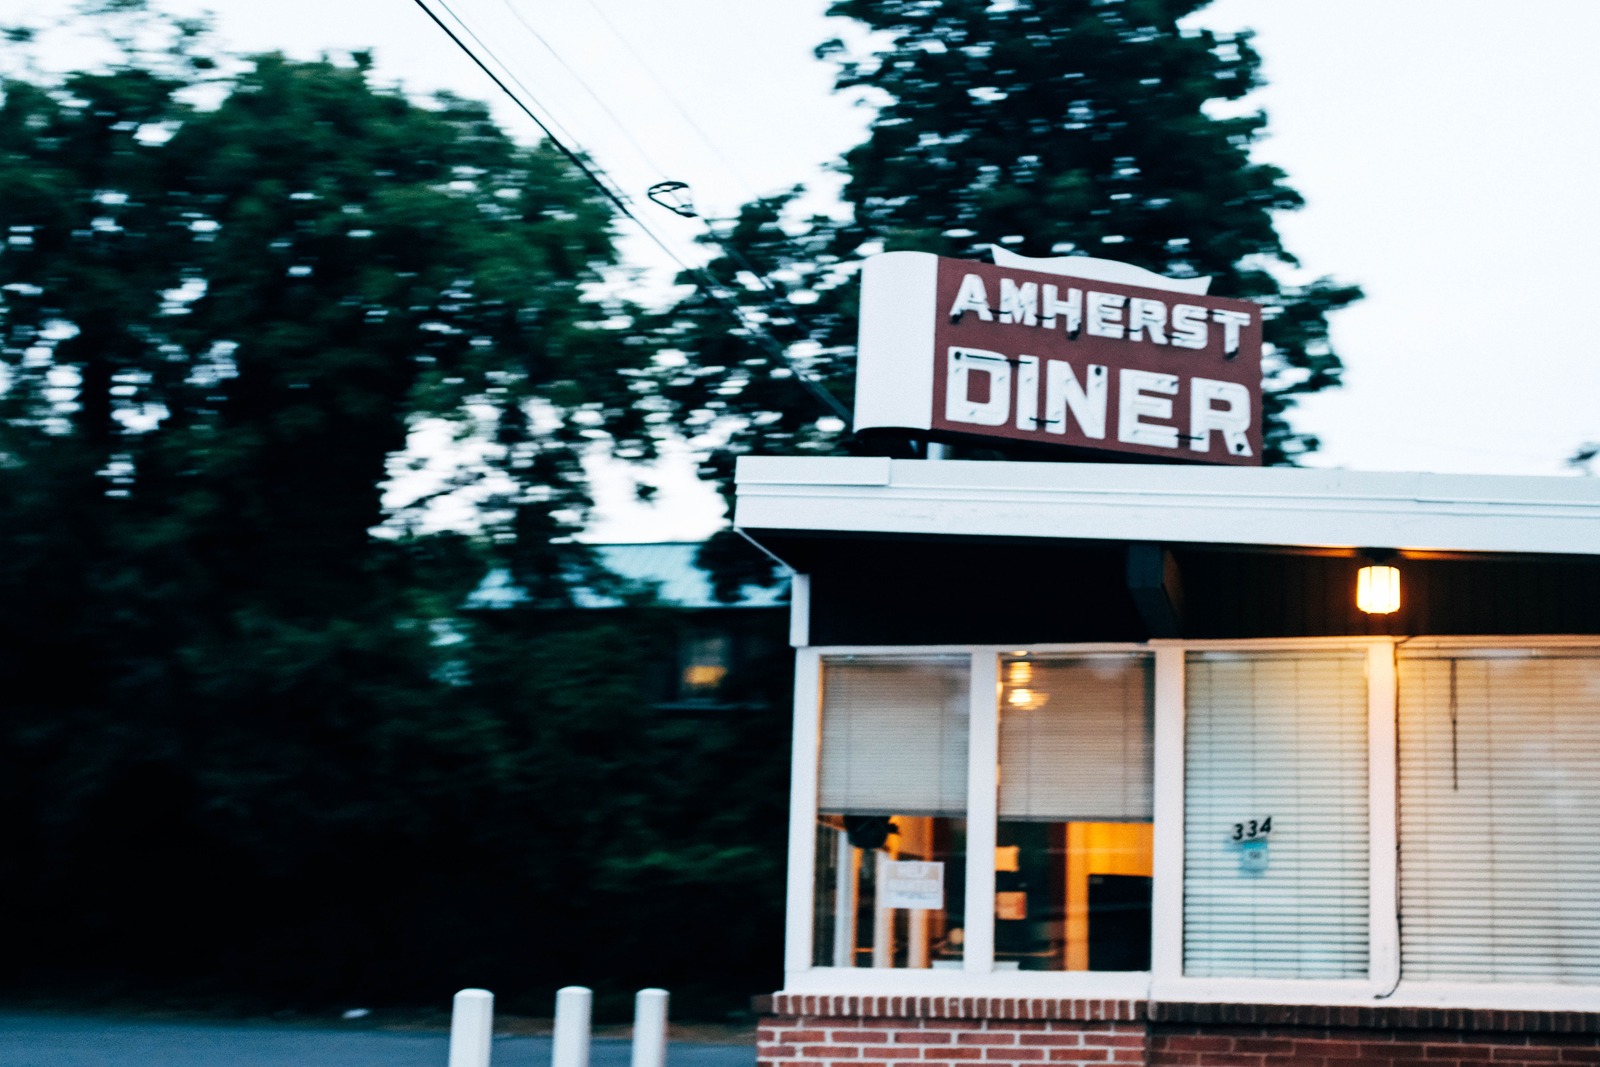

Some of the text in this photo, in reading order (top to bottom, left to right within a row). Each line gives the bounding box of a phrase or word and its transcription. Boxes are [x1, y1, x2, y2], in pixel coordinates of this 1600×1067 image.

[949, 273, 1251, 355] AMHERST
[945, 346, 1253, 457] DINER
[1232, 816, 1272, 841] 334
